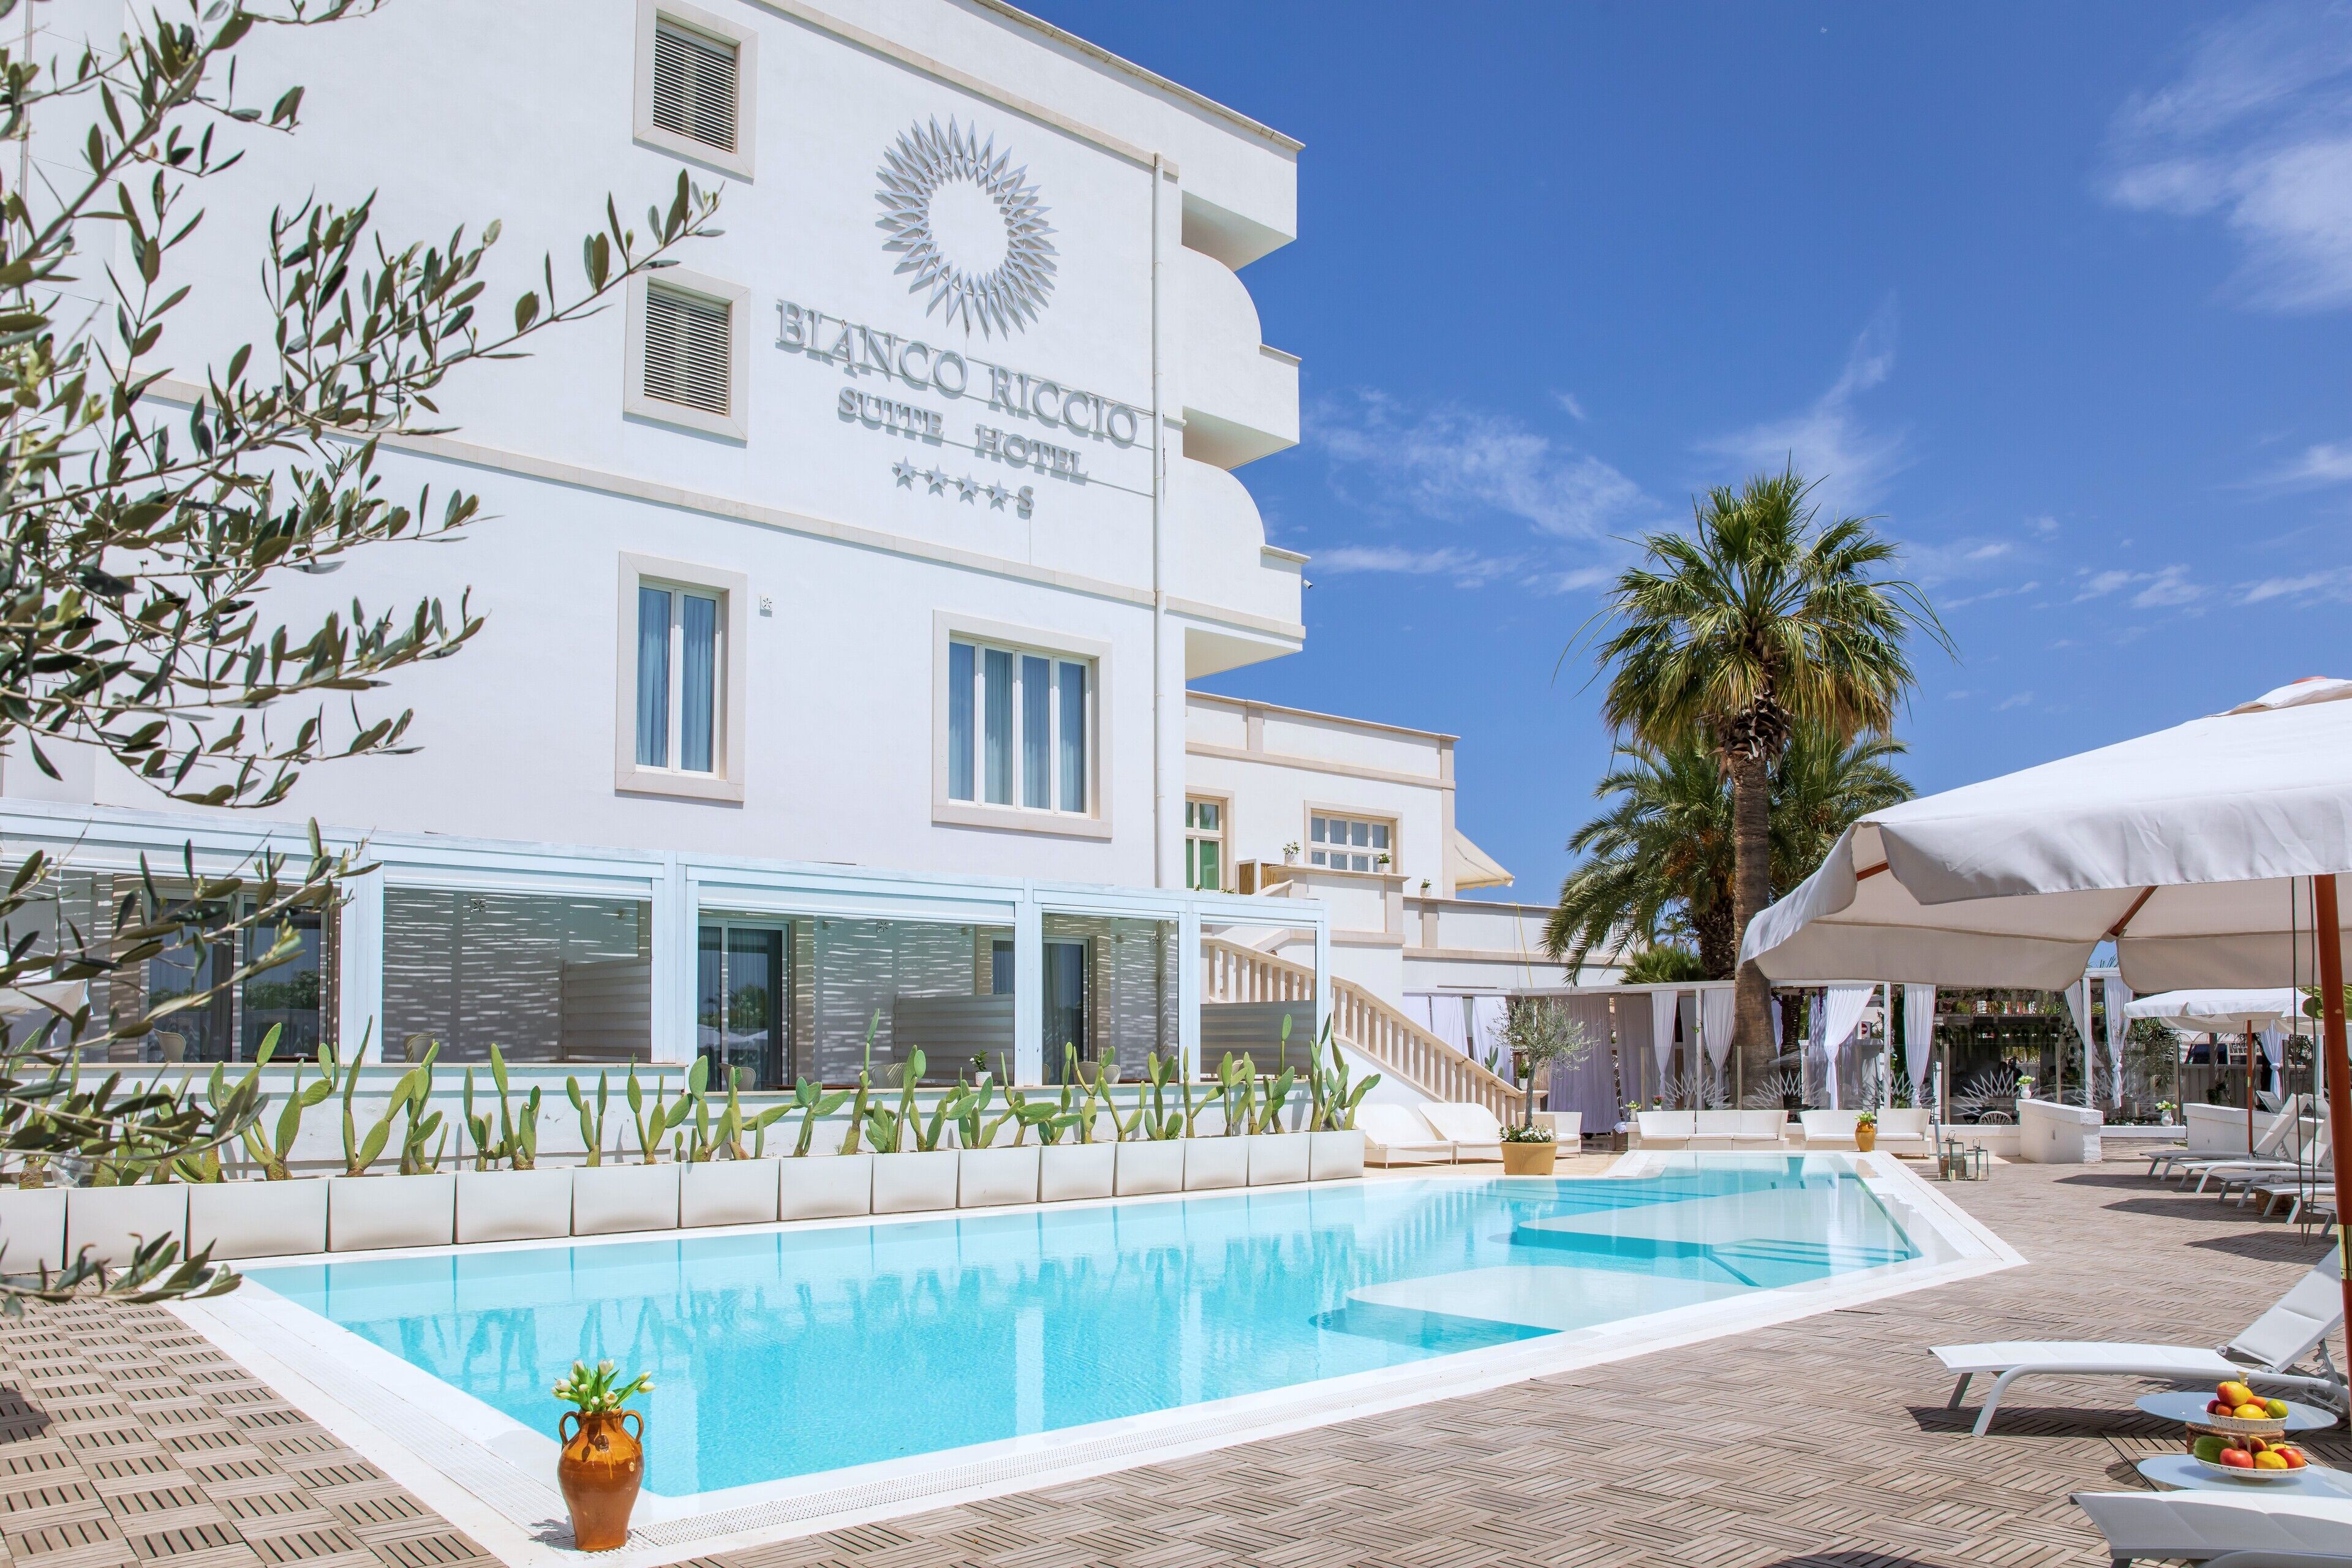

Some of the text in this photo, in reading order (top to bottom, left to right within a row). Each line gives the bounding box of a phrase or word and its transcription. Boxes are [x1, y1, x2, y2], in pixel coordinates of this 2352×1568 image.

[776, 299, 1137, 442] BIANCO RICCIO
[839, 386, 1088, 477] SUITE HOTEL
[1018, 485, 1035, 511] S
